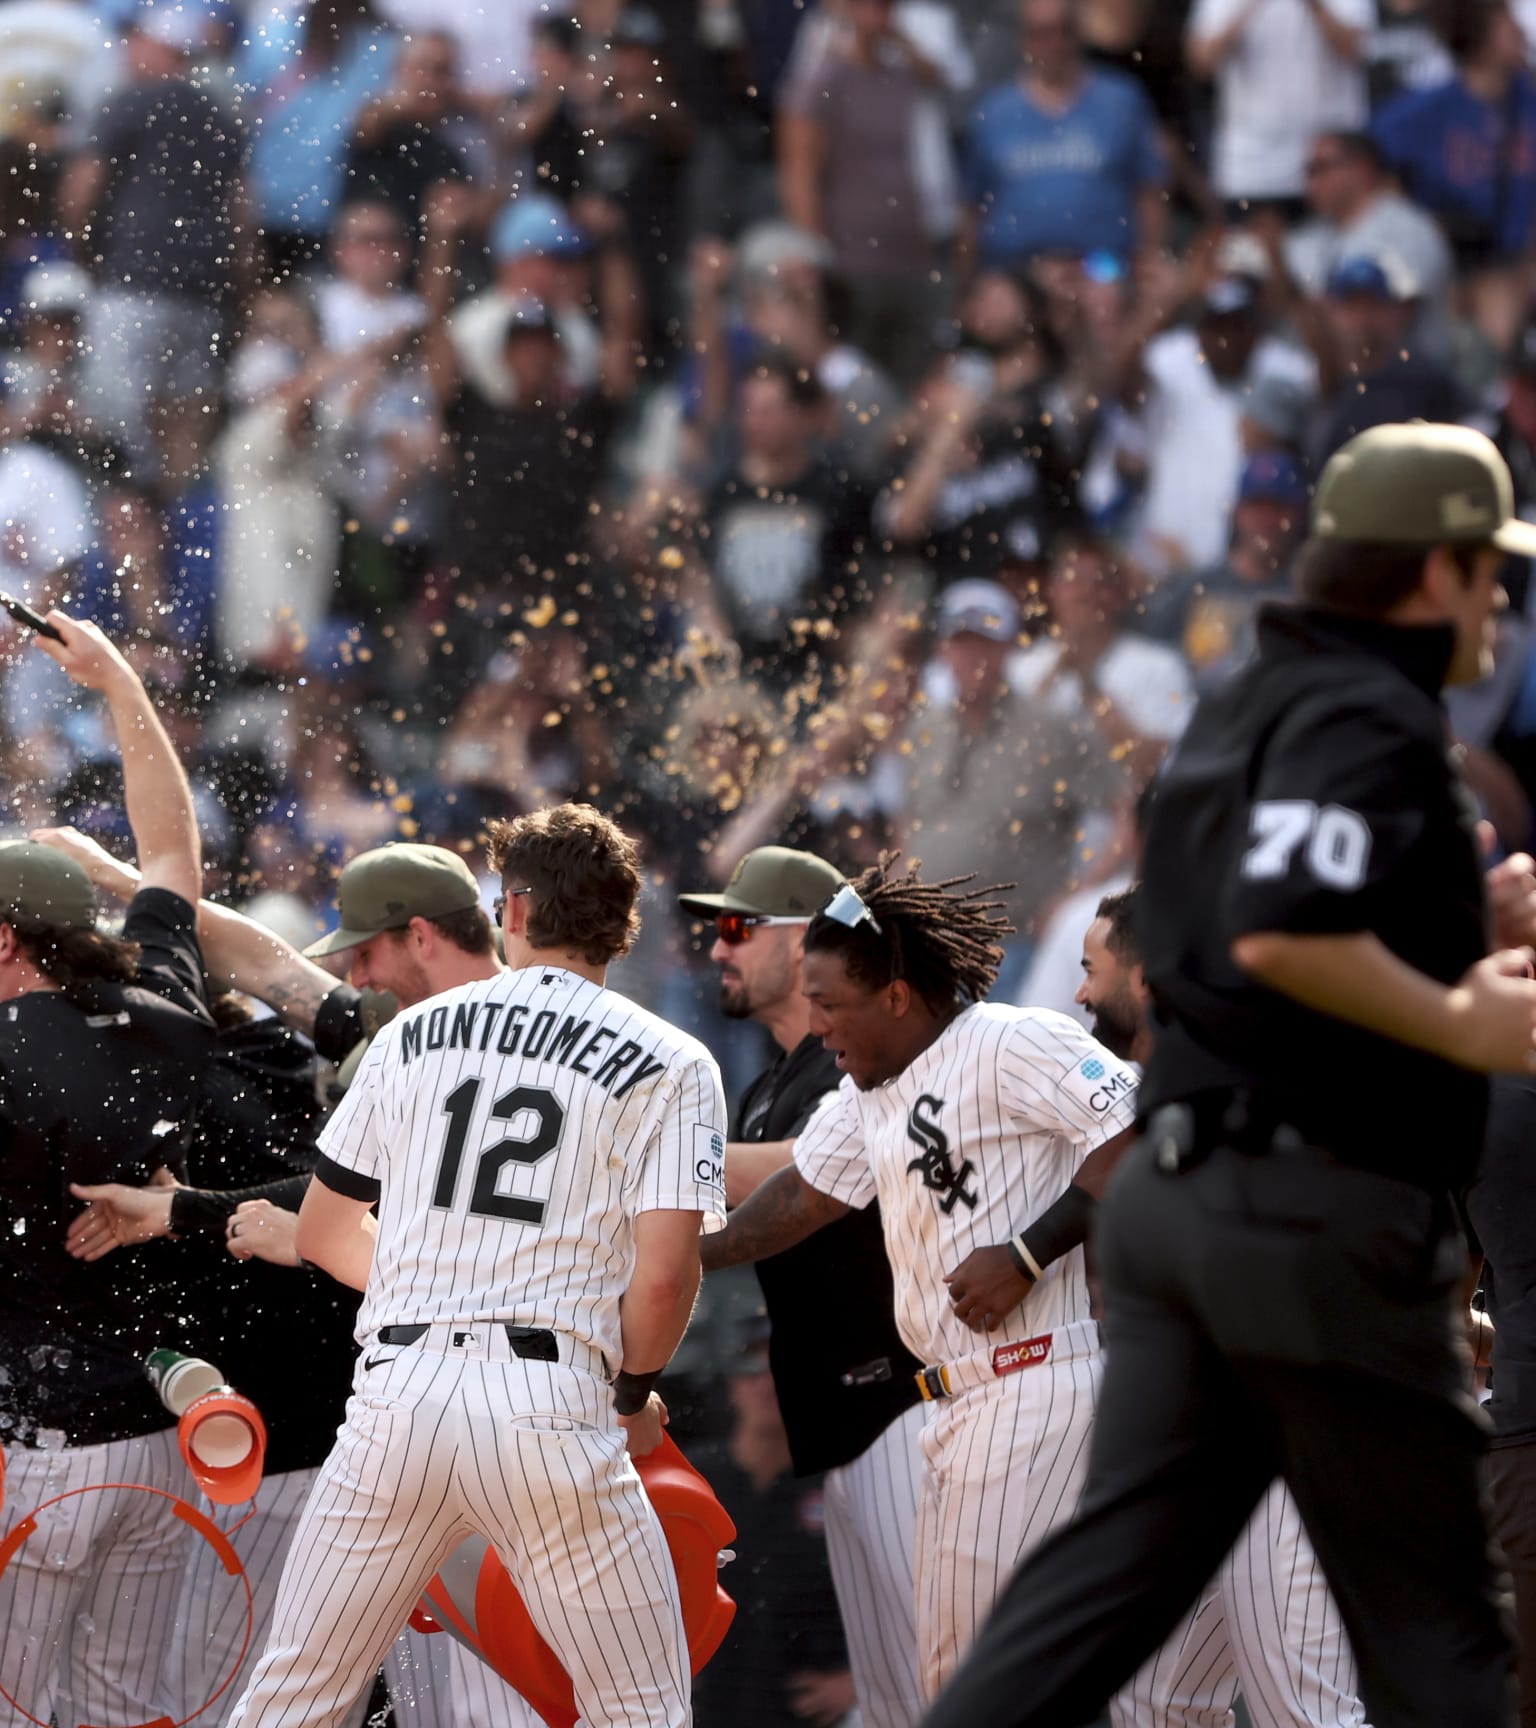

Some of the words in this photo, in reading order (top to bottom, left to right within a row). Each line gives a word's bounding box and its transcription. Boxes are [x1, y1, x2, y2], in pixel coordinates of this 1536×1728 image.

[1241, 799, 1373, 891] 70
[401, 1001, 666, 1101] MONTGOMERY
[1089, 1072, 1135, 1113] CME
[429, 1075, 570, 1228] 12
[696, 1160, 725, 1187] CM
